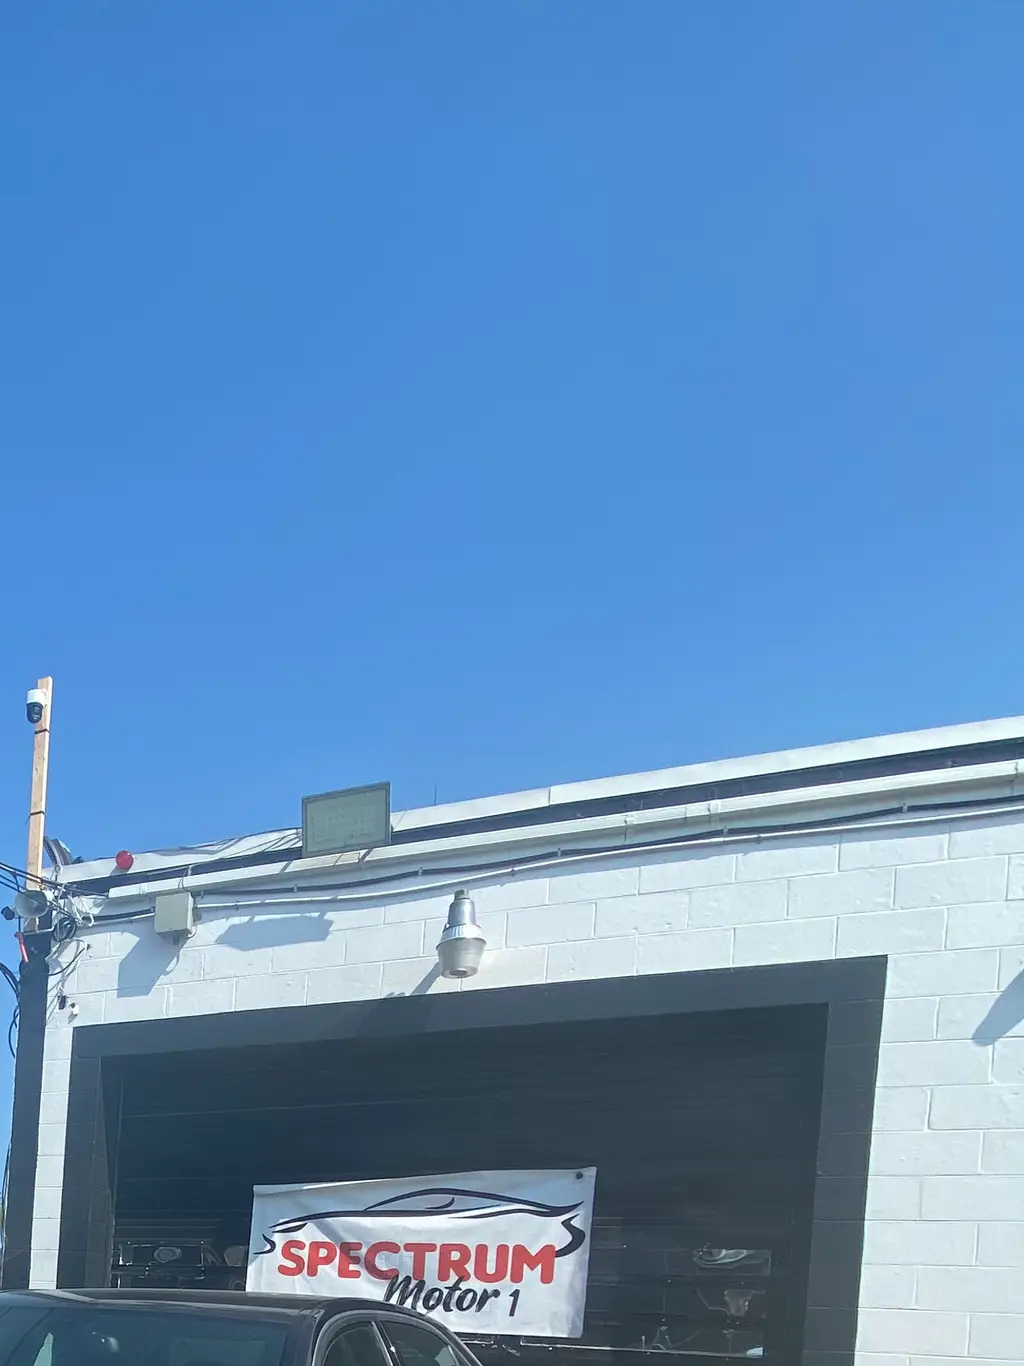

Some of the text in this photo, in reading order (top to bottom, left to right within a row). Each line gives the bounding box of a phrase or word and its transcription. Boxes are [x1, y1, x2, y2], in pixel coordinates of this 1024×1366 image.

[277, 1239, 557, 1285] SPECTRUM
[383, 1274, 521, 1317] Motor 1
